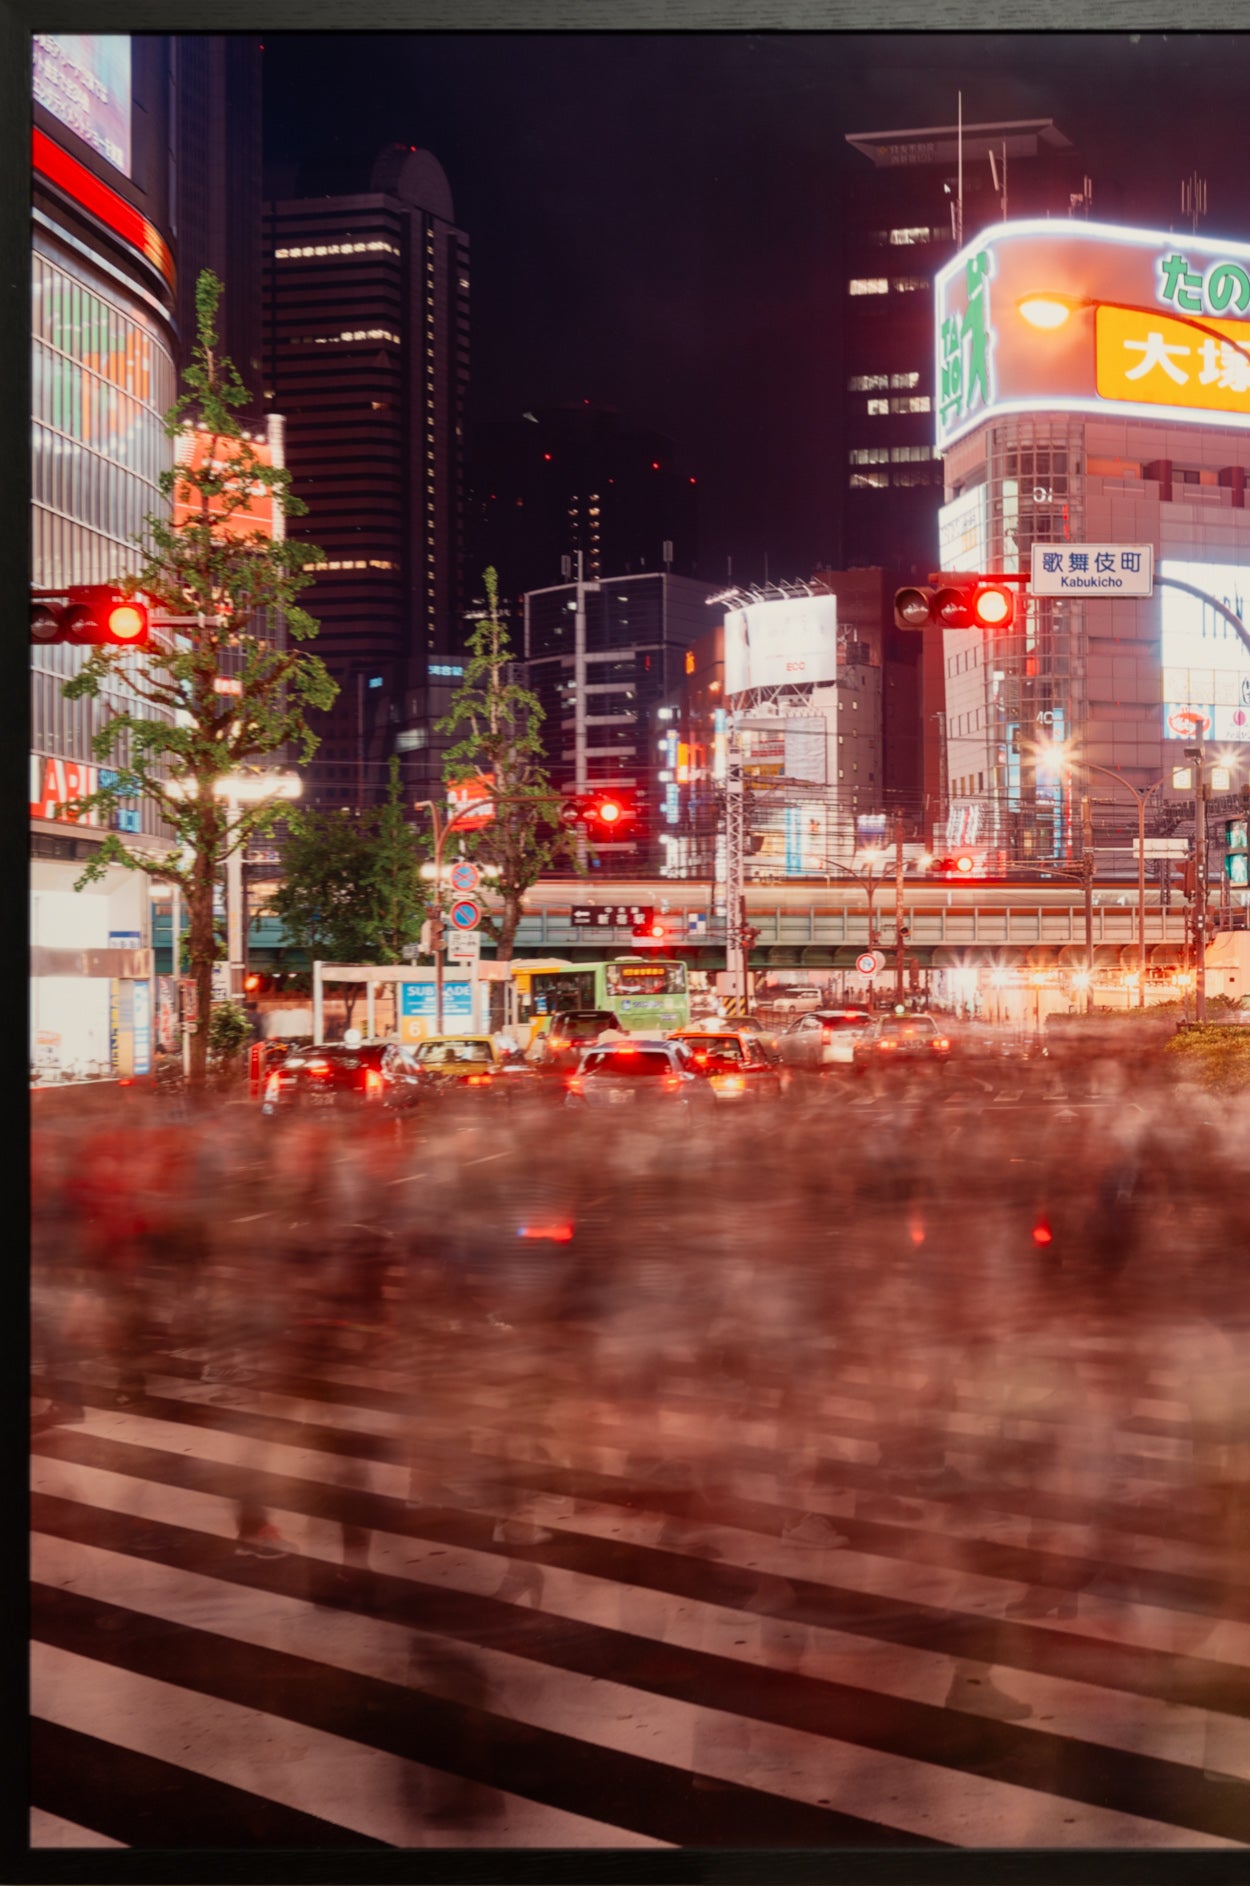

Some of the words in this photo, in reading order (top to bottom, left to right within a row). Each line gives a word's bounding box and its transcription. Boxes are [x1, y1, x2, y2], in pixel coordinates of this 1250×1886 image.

[1042, 552, 1141, 573] 歌舞伎町
[1061, 576, 1123, 588] Kabukicho
[407, 985, 472, 997] SUBADE
